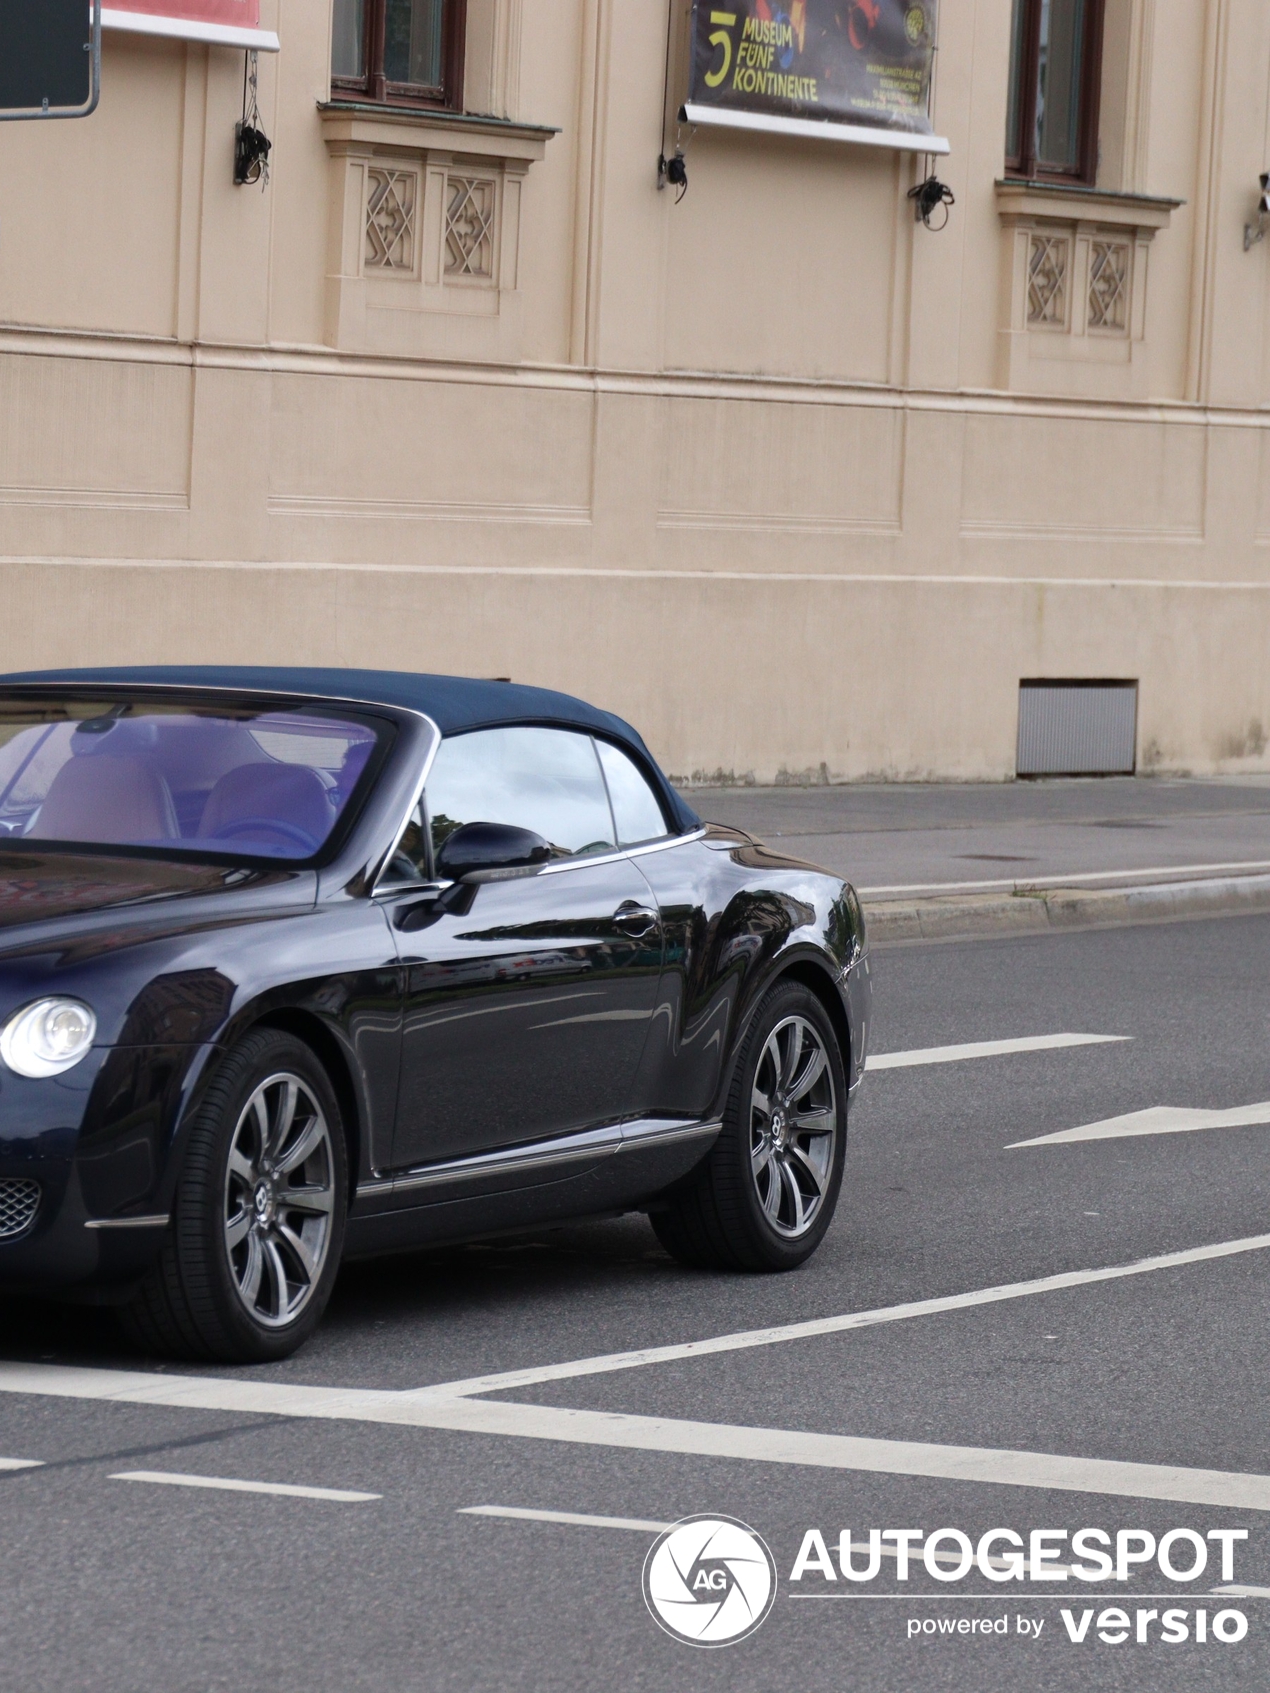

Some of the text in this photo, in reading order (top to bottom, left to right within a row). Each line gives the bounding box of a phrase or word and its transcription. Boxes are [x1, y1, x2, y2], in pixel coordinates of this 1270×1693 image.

[742, 16, 792, 48] MUSEUM
[704, 11, 736, 88] 5
[737, 41, 775, 70] FÜNF
[733, 67, 818, 102] KONTINENTE
